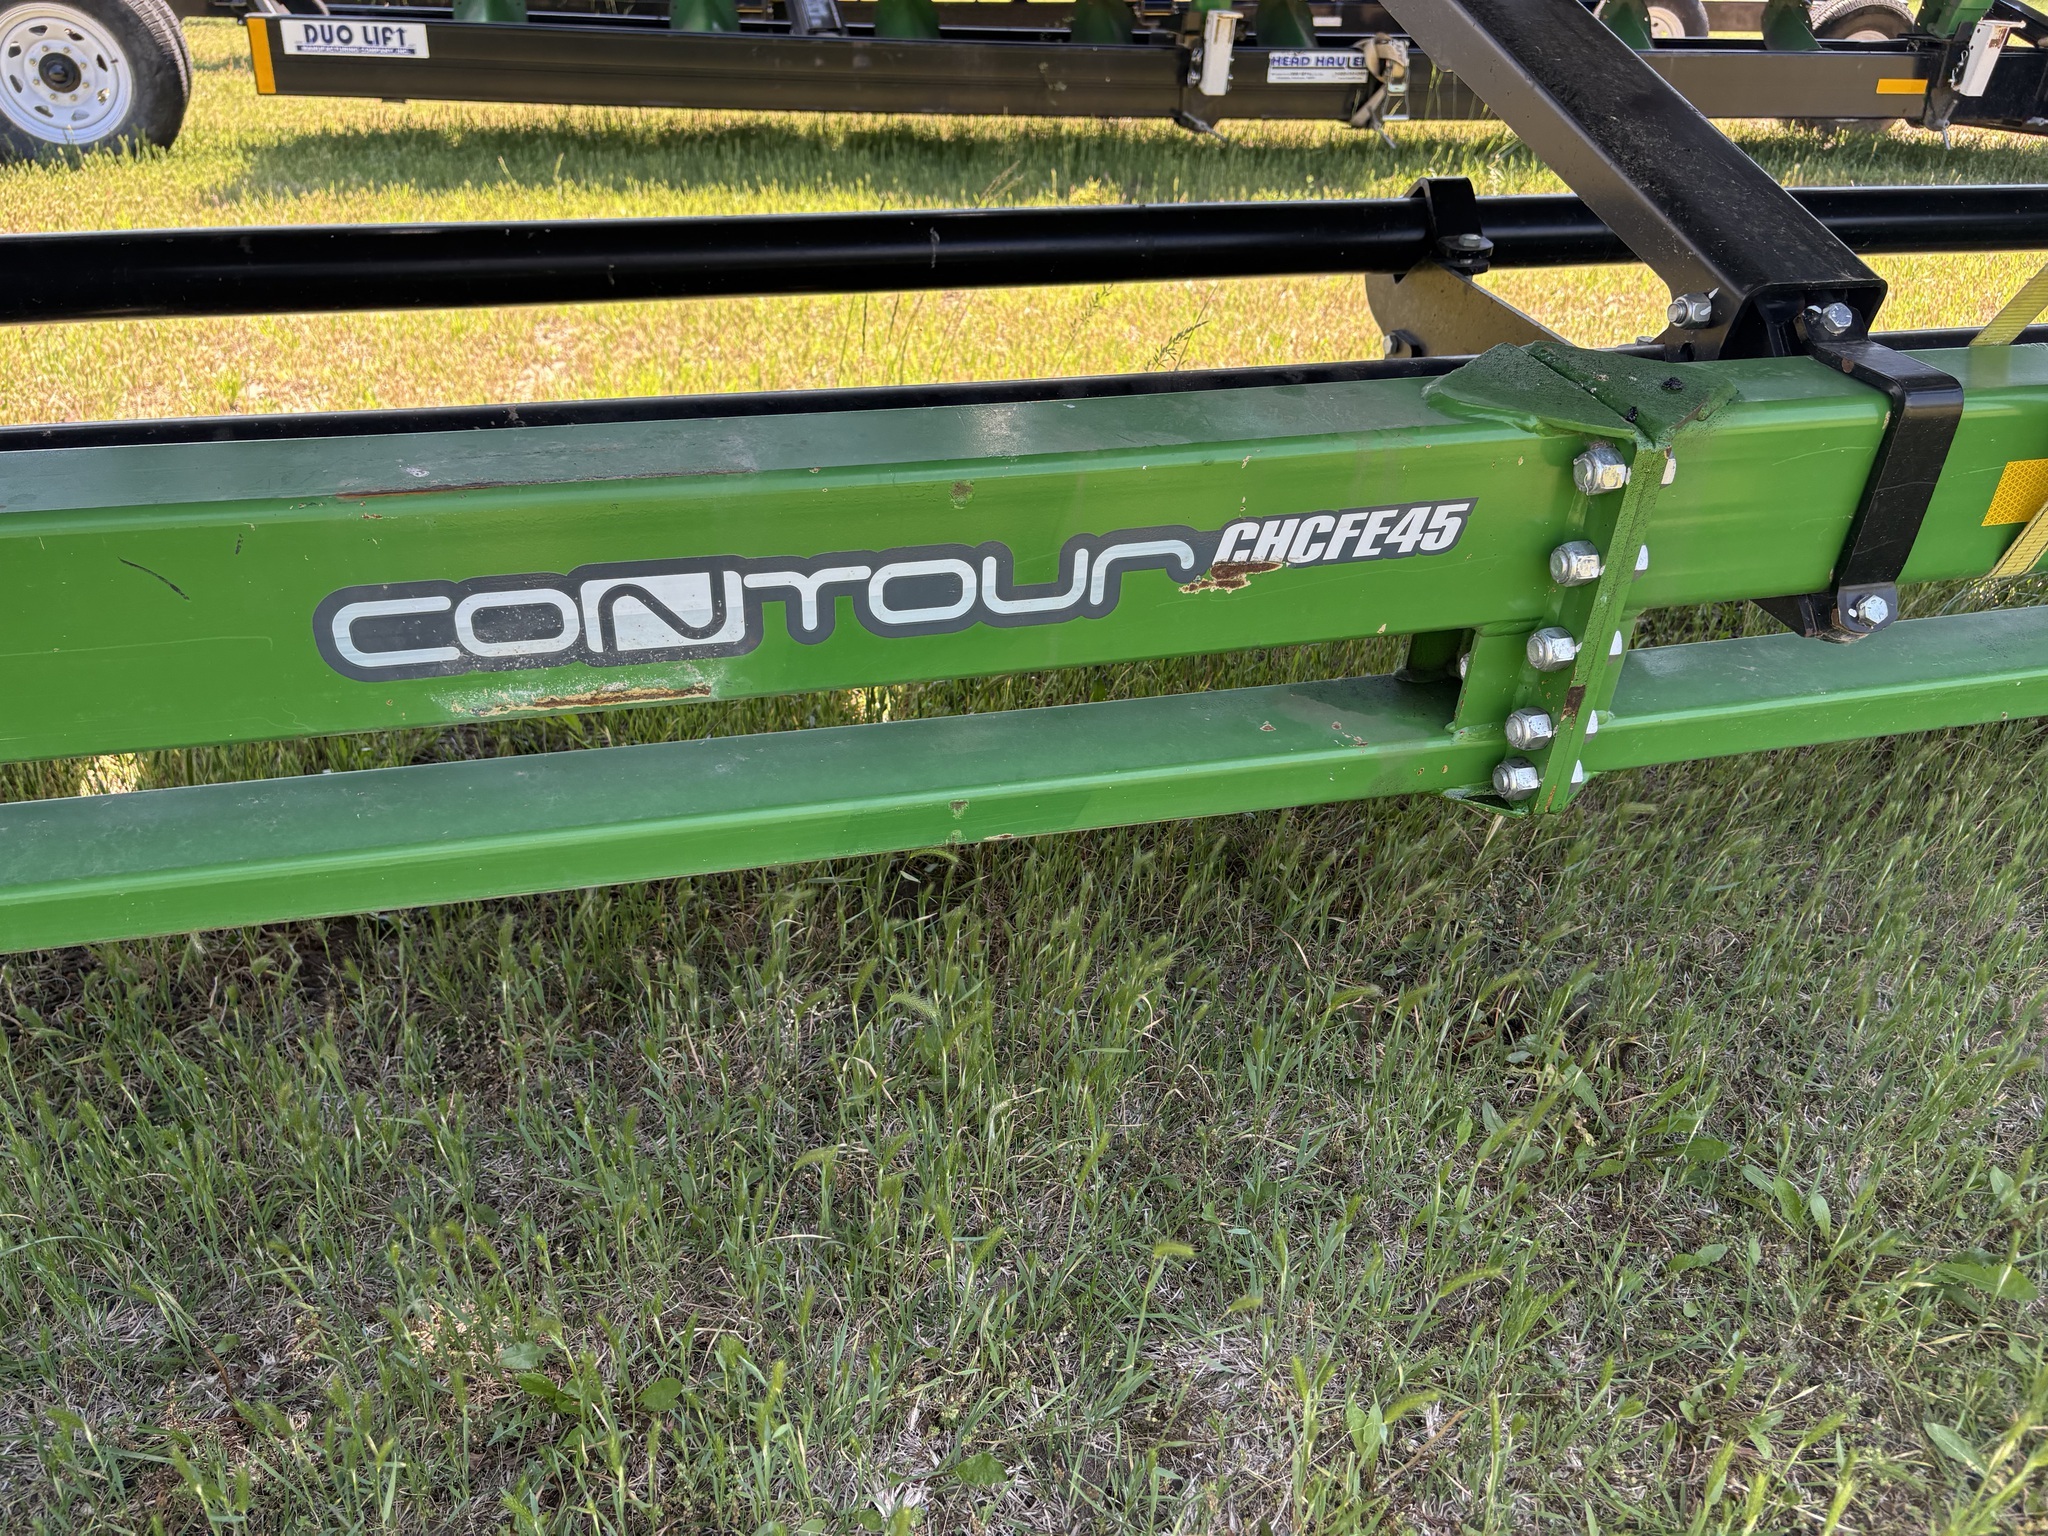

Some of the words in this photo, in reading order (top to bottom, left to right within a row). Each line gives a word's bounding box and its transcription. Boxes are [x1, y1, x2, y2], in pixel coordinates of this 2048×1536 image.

[303, 24, 353, 44] DUO
[362, 25, 407, 46] LIFT
[1271, 56, 1310, 67] HEAD
[332, 539, 1195, 668] CONTOUR
[1211, 502, 1471, 566] CHCFE45
